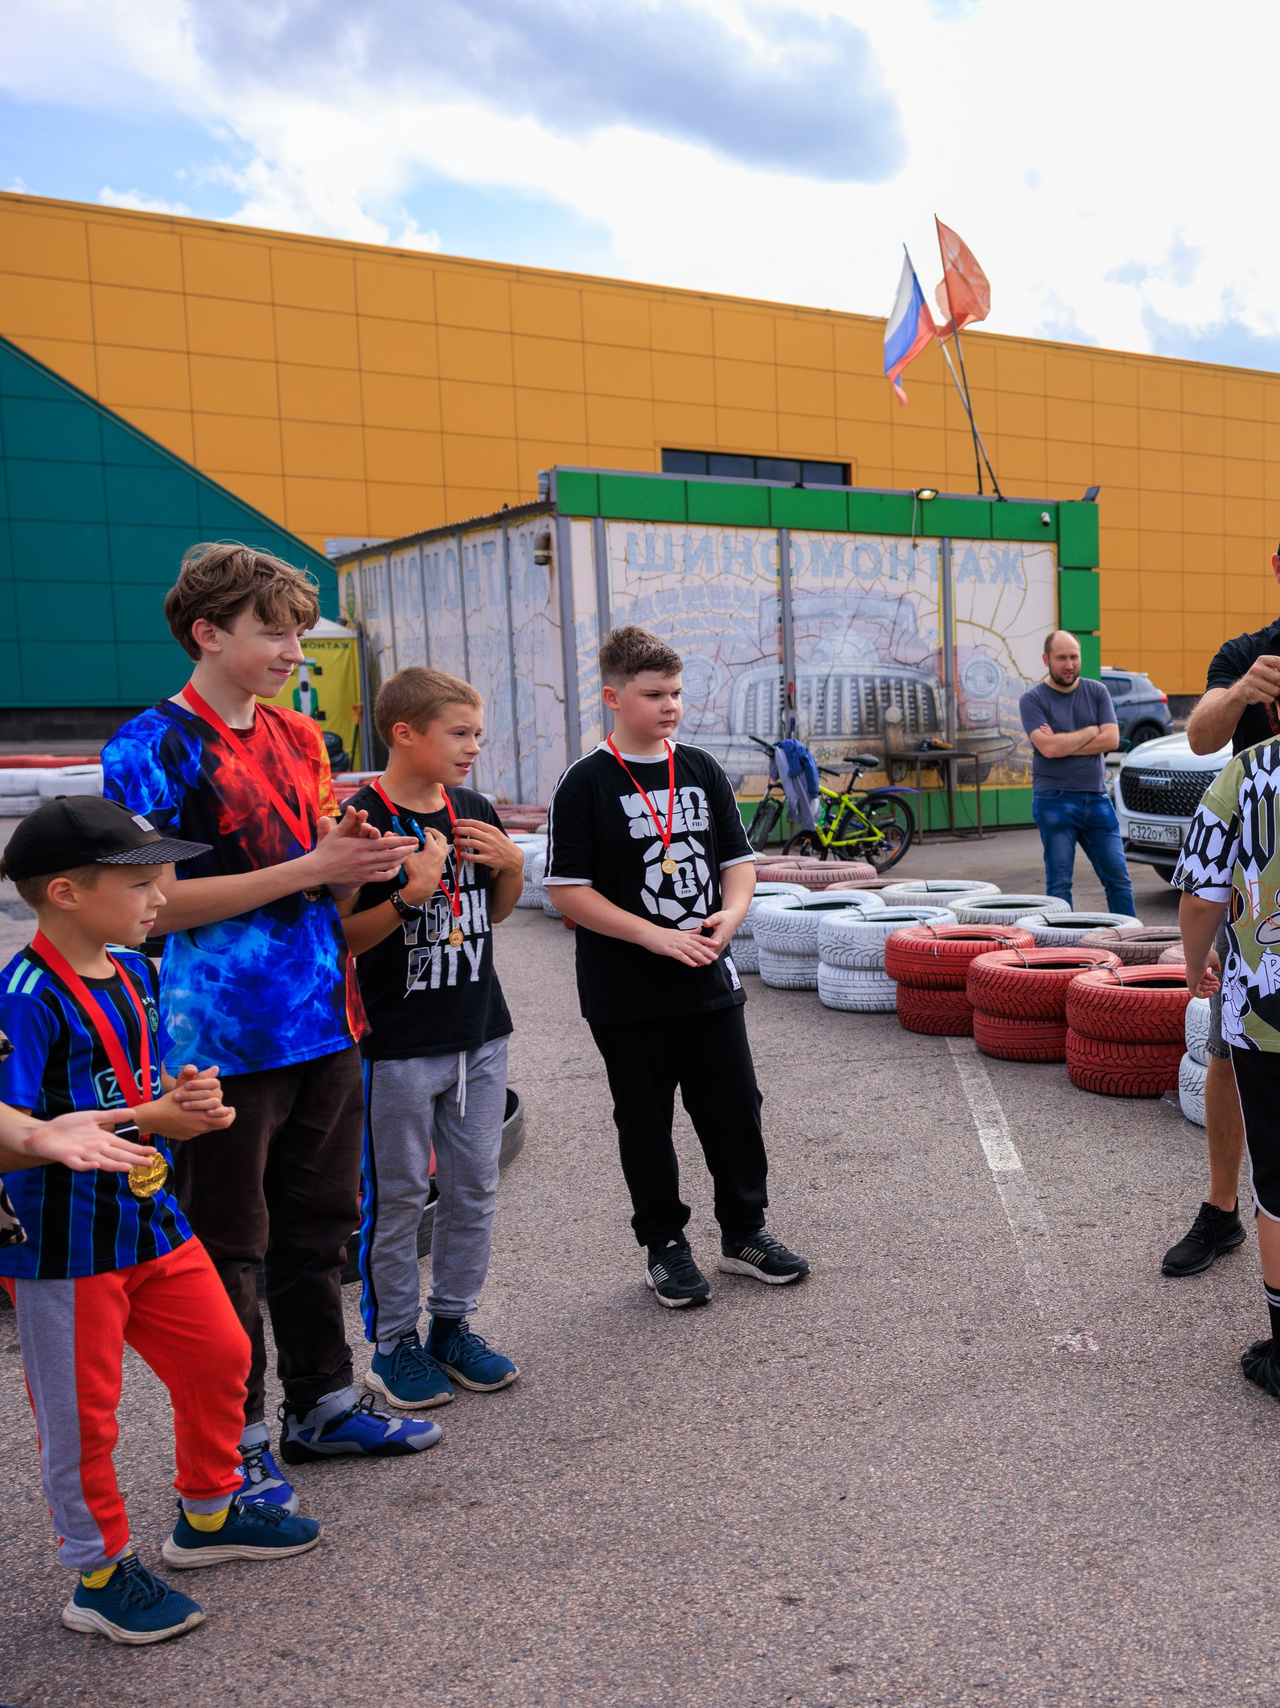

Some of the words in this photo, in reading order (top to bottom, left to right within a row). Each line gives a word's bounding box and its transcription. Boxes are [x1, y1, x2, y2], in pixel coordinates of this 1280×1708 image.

[626, 531, 1025, 585] ШИНОМОНТАЖ
[1164, 827, 1178, 839] 198
[406, 938, 485, 991] CITY
